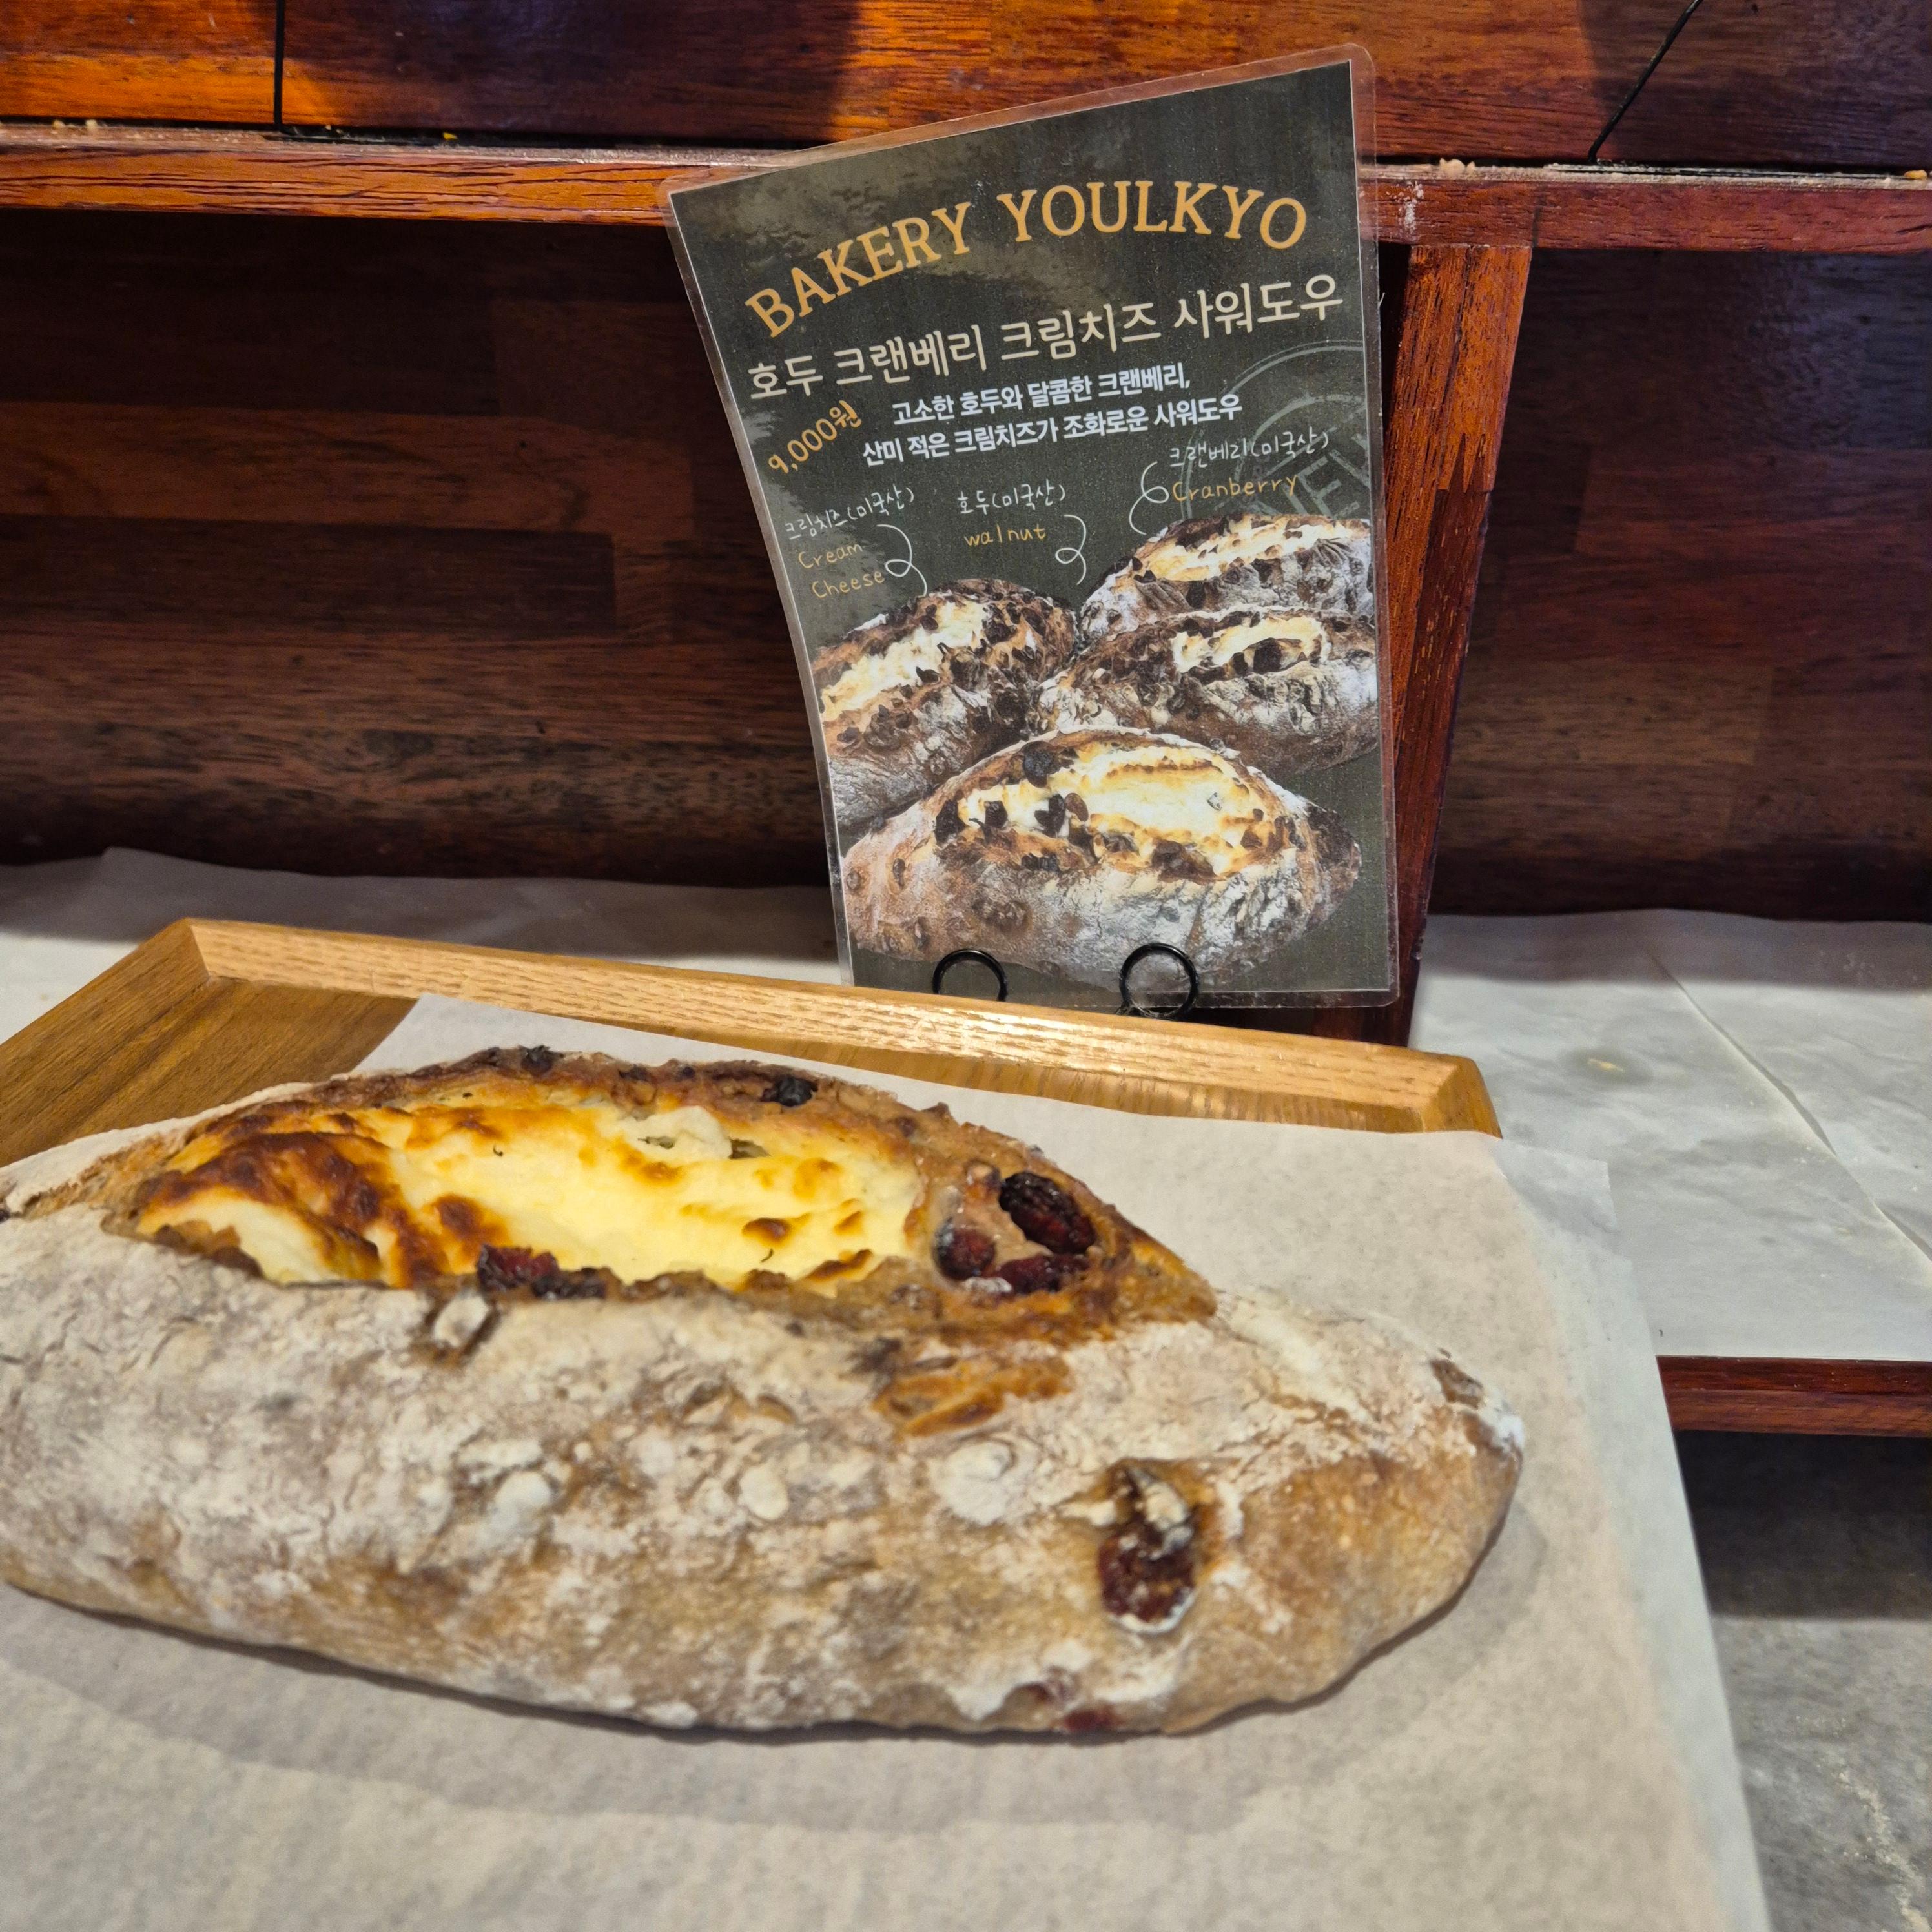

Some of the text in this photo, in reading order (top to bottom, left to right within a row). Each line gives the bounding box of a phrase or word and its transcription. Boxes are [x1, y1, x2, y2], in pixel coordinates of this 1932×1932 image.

[745, 180, 1308, 338] BAKERY YOULKYO
[747, 274, 1344, 400] 호두 크랜베리 크림치즈 사워도우
[892, 362, 1191, 426] 고소한 호두와 달콤한 크랜베리,
[768, 400, 862, 474] 9,000원
[862, 393, 1243, 468] 산미 적은 크림치즈가 조화로운 사워도우
[1172, 473, 1299, 502] Cranberry
[797, 543, 863, 569] Cream
[963, 522, 1047, 546] walnut
[812, 571, 885, 599] Cheese
